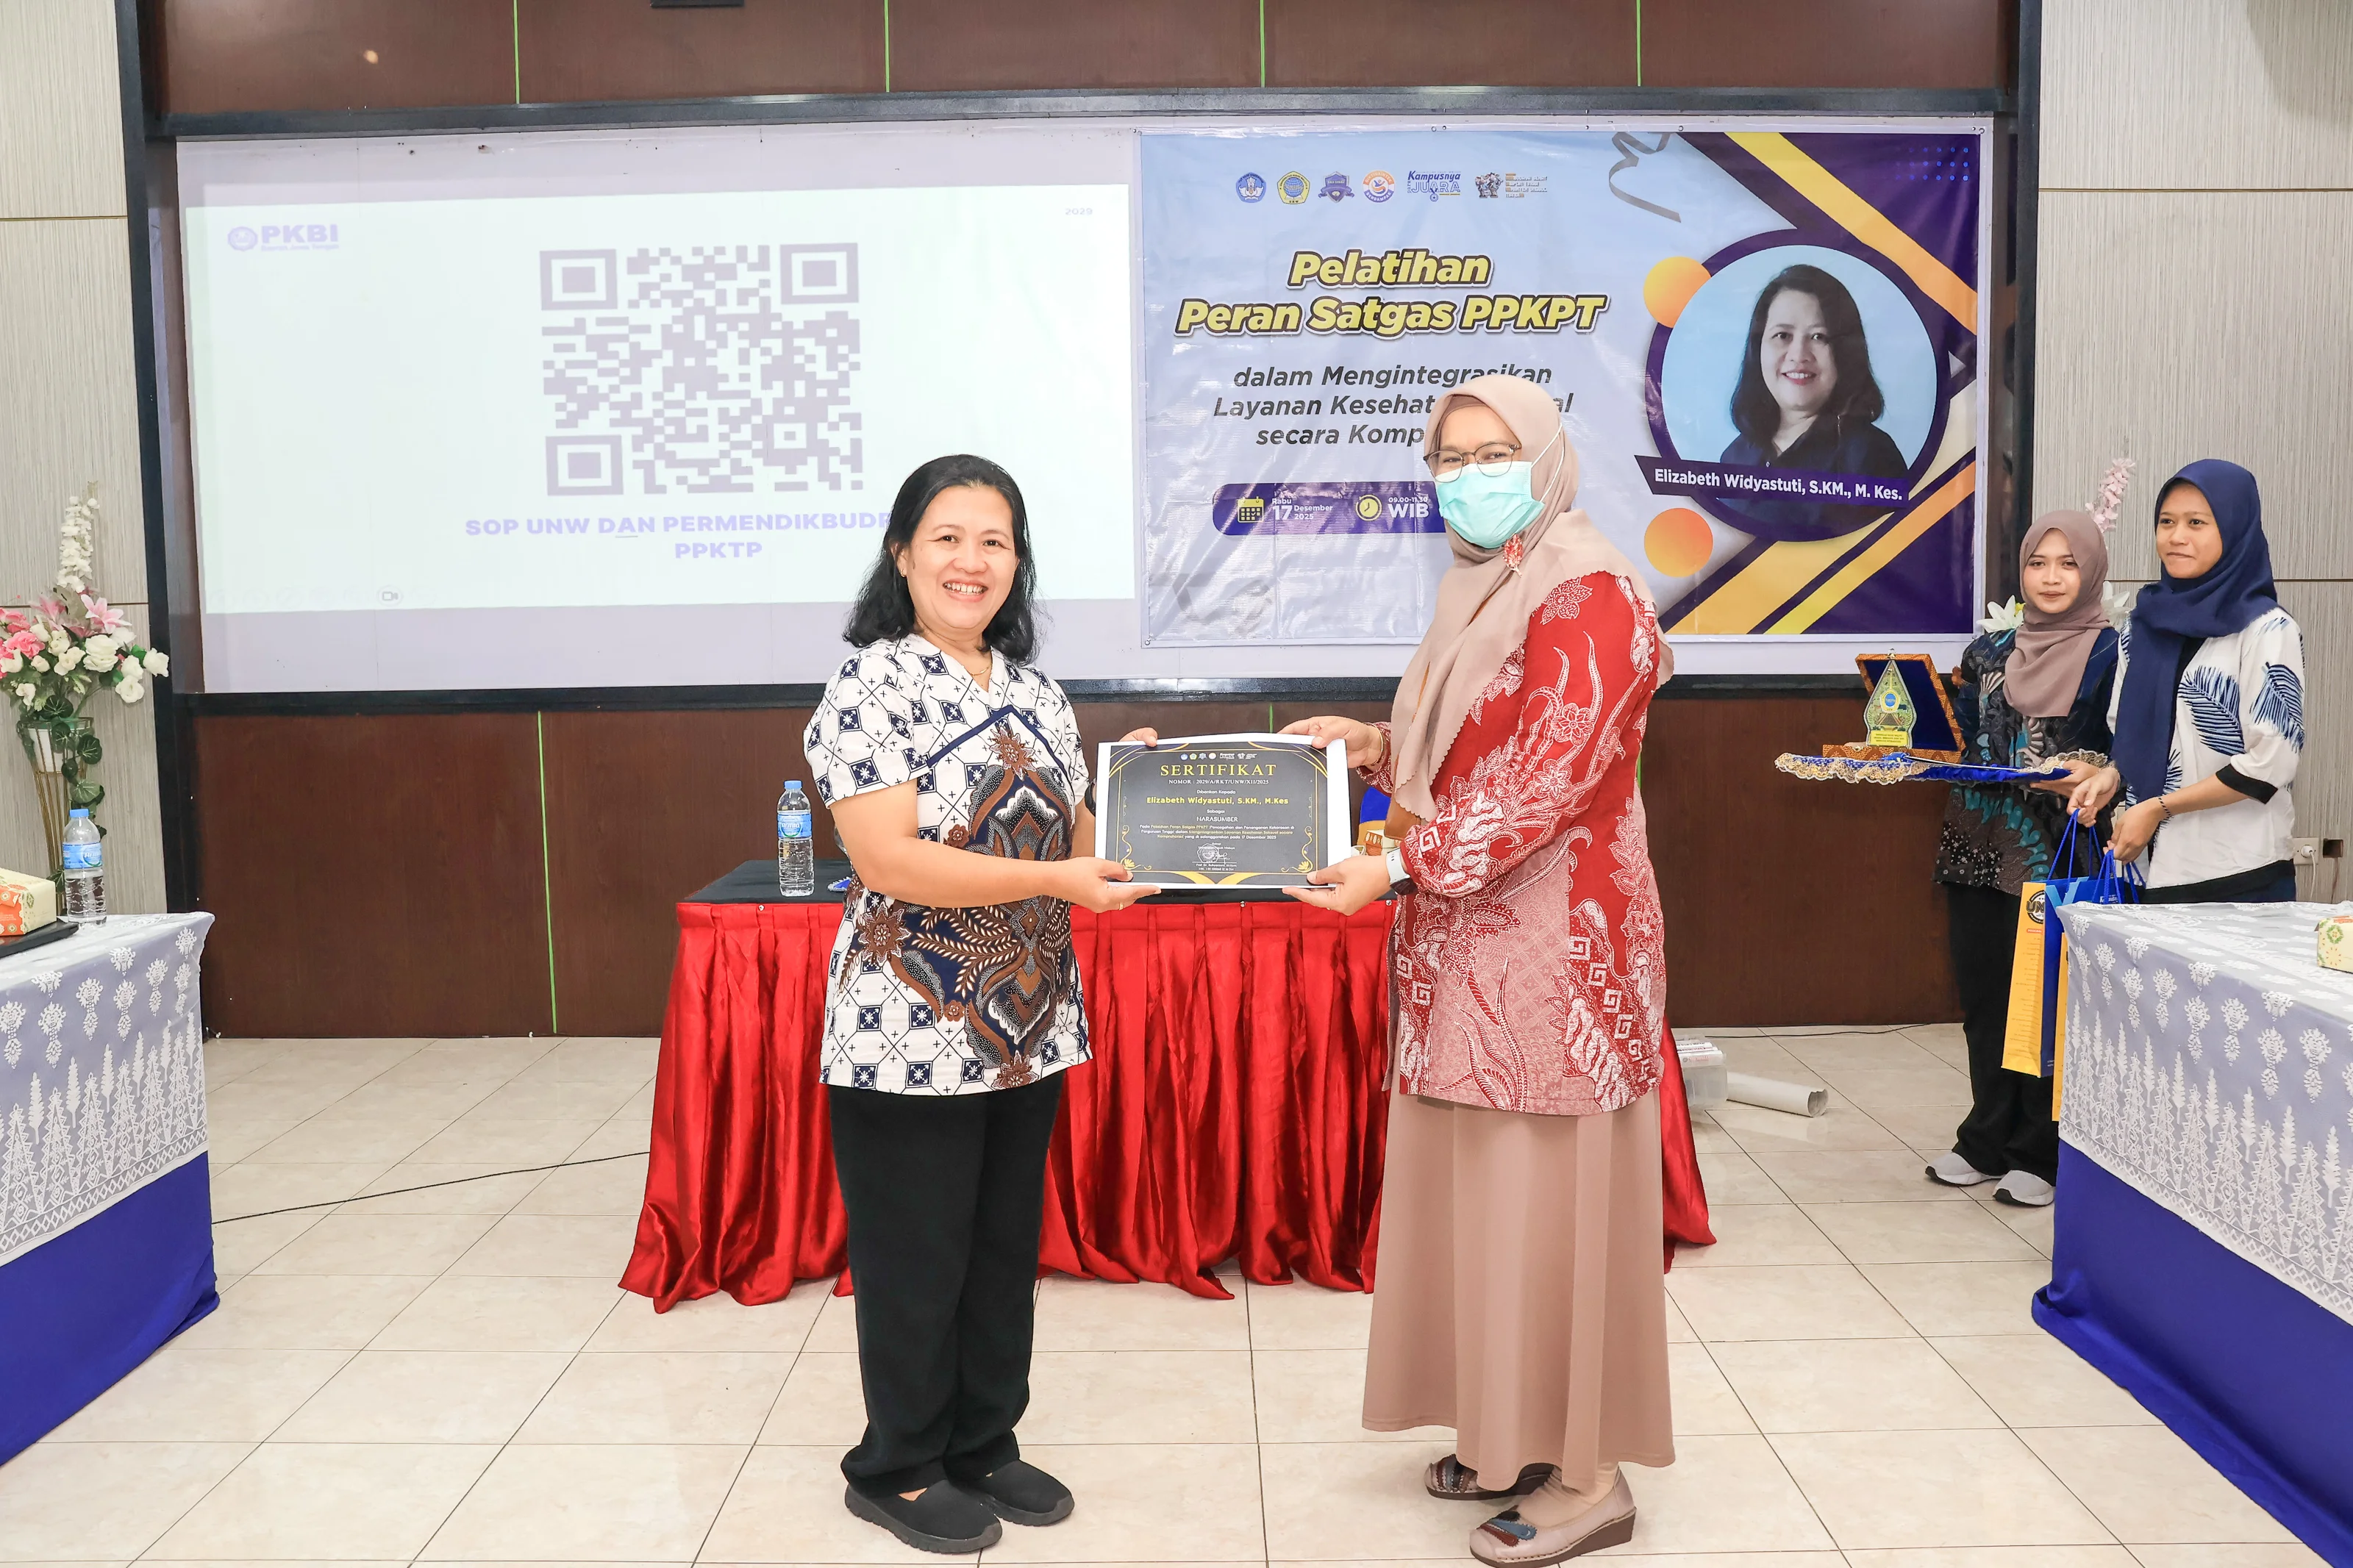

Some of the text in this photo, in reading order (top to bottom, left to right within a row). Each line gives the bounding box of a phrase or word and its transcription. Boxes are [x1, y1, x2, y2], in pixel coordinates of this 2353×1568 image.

[1408, 171, 1461, 183] Kampusnya
[1411, 182, 1461, 193] JUARA
[261, 223, 338, 244] PKBI
[1288, 250, 1491, 286] Pelatihan
[1176, 296, 1608, 337] Peran Satgas PPKPT
[1234, 367, 1313, 387] dalam
[1213, 397, 1321, 420] Layanan
[1256, 427, 1339, 445] secara
[1654, 469, 1902, 501] Elizabeth Widyastuti, S.KM., M. Kes.
[1273, 505, 1293, 520] 17
[1388, 503, 1429, 518] WIB
[465, 520, 518, 536] SOP
[526, 518, 590, 534] UNW
[599, 517, 655, 534] DAN
[675, 542, 763, 559] PPKTP
[1160, 764, 1277, 776] SERTIFIKAT
[1188, 797, 1235, 805] Widyastuti,
